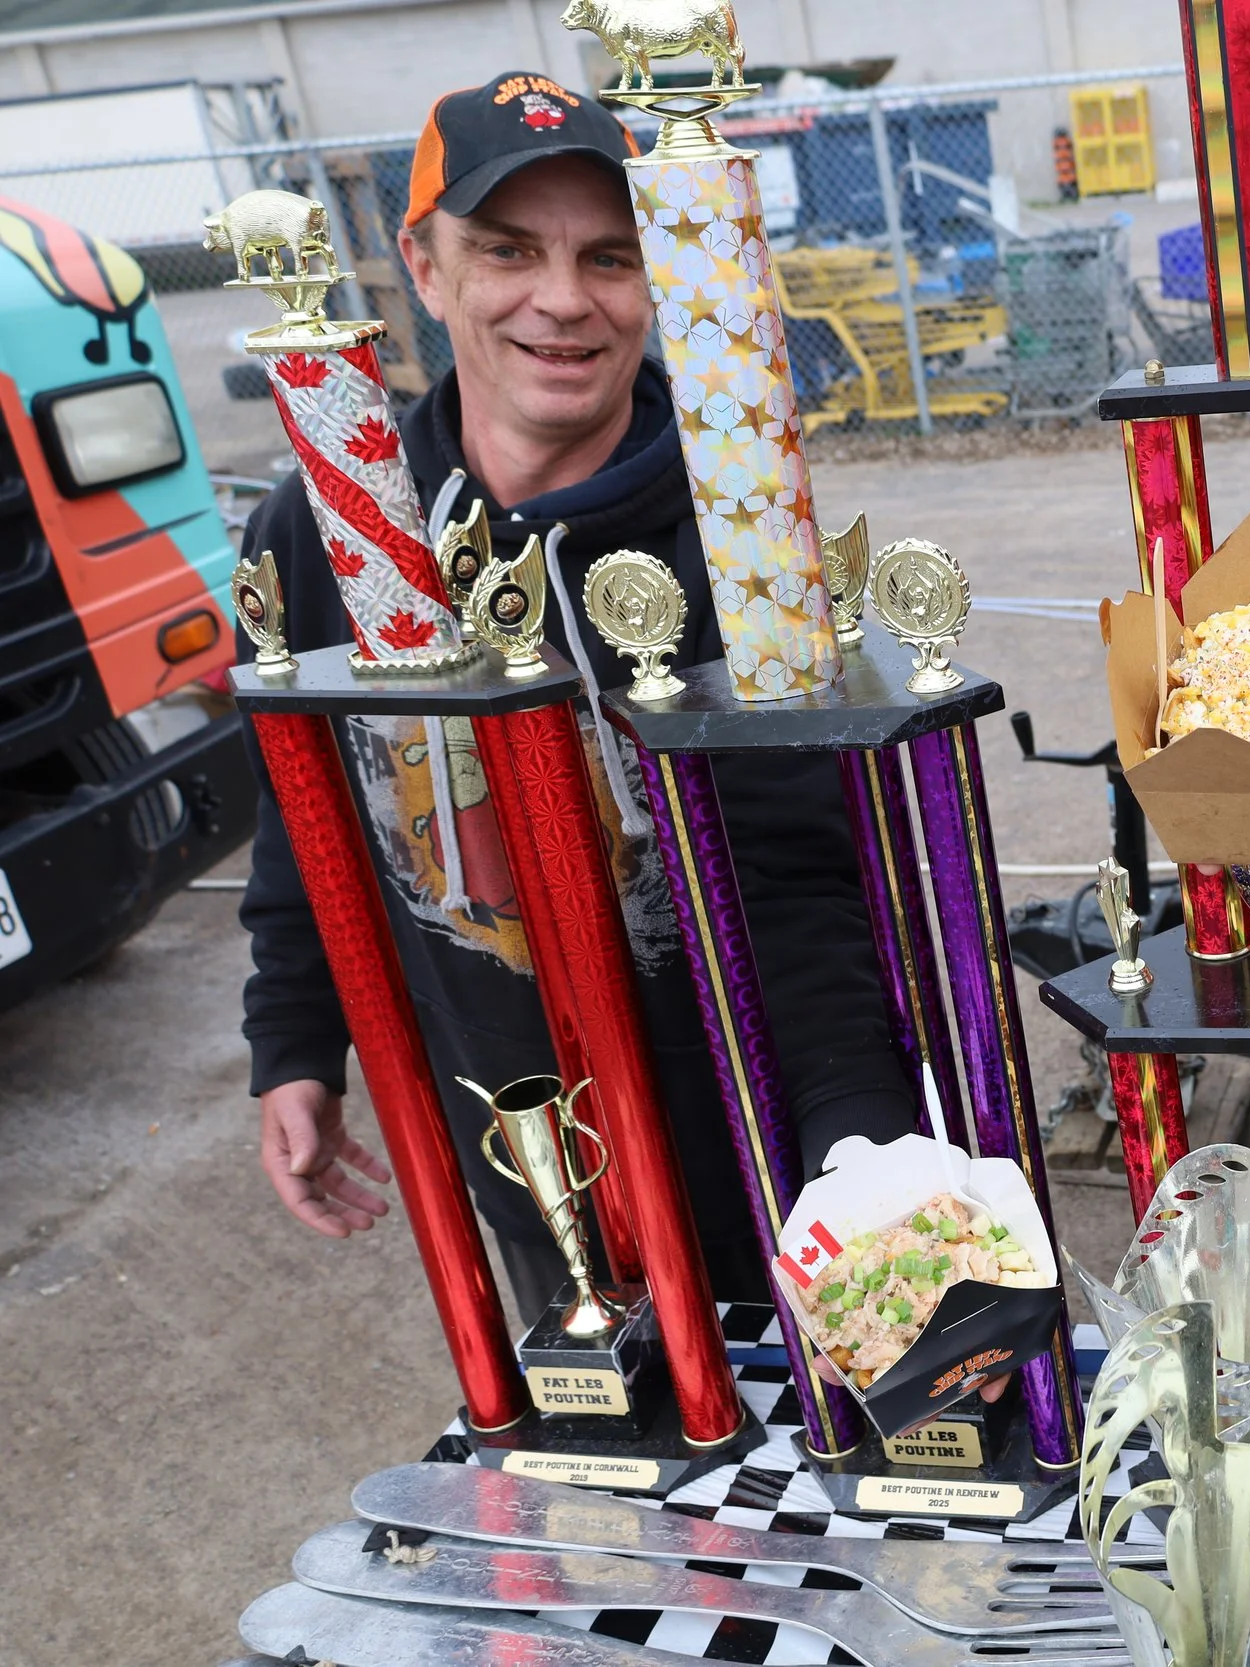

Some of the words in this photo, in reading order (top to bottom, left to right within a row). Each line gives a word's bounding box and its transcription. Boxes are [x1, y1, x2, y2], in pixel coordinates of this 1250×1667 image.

[933, 1363, 964, 1387] FAT
[542, 1377, 569, 1388] FAT
[543, 1393, 612, 1405] POUTINE
[894, 1444, 966, 1458] POUTINE
[523, 1460, 544, 1468] BEST
[545, 1461, 581, 1471] POUTINE
[582, 1463, 593, 1471] IN
[593, 1463, 640, 1473] CORNWALL
[881, 1485, 903, 1494] BEST
[905, 1486, 943, 1495] POUTINE
[944, 1488, 954, 1496] IN
[928, 1499, 950, 1507] 2025
